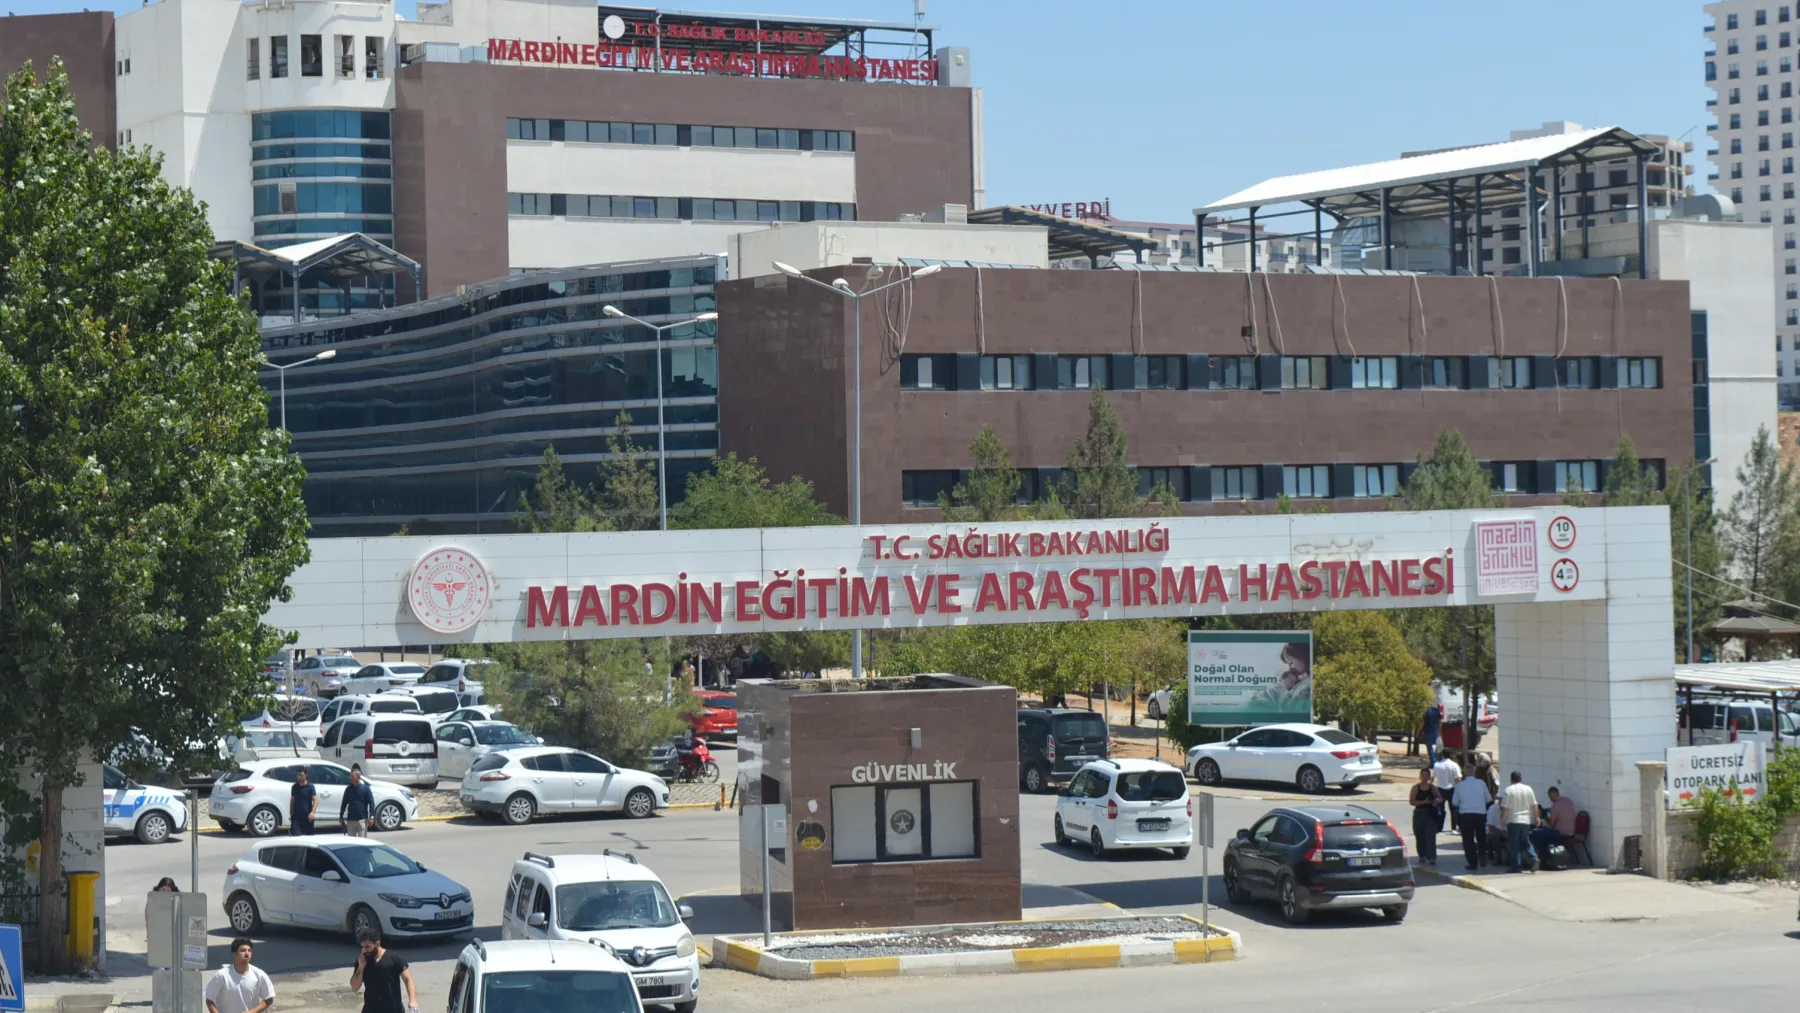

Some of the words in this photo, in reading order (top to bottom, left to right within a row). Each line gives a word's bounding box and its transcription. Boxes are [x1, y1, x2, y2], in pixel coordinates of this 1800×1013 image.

[667, 21, 728, 40] SAĞLIK
[734, 27, 825, 45] BAKANLIĞI
[487, 36, 578, 64] MARDİN
[581, 38, 656, 68] EĞİTİM
[659, 48, 690, 70] VE
[693, 50, 822, 76] ARAŞTIRMA
[823, 55, 939, 80] HASTANESİ
[1021, 197, 1109, 218] YVERDİ
[1556, 521, 1570, 532] 10
[870, 535, 919, 560] T.C.
[928, 527, 1021, 558] SAĞLIK
[1028, 522, 1170, 556] BAKANLIĞI
[1556, 568, 1564, 580] 4
[527, 571, 722, 628] MARDİN
[735, 567, 891, 622] EĞİTİM
[903, 574, 961, 615] VE
[976, 564, 1228, 619] ARAŞTIRMA
[1239, 547, 1454, 601] HASTANESİ
[1194, 664, 1226, 675] Doğal
[1228, 664, 1255, 673] Olan
[1194, 674, 1235, 683] Normal
[1237, 674, 1278, 685] Doğum
[851, 759, 958, 783] GÜVENLİK
[1691, 753, 1744, 770] ÜCRETSİZ
[1674, 774, 1727, 788] OTOPARK
